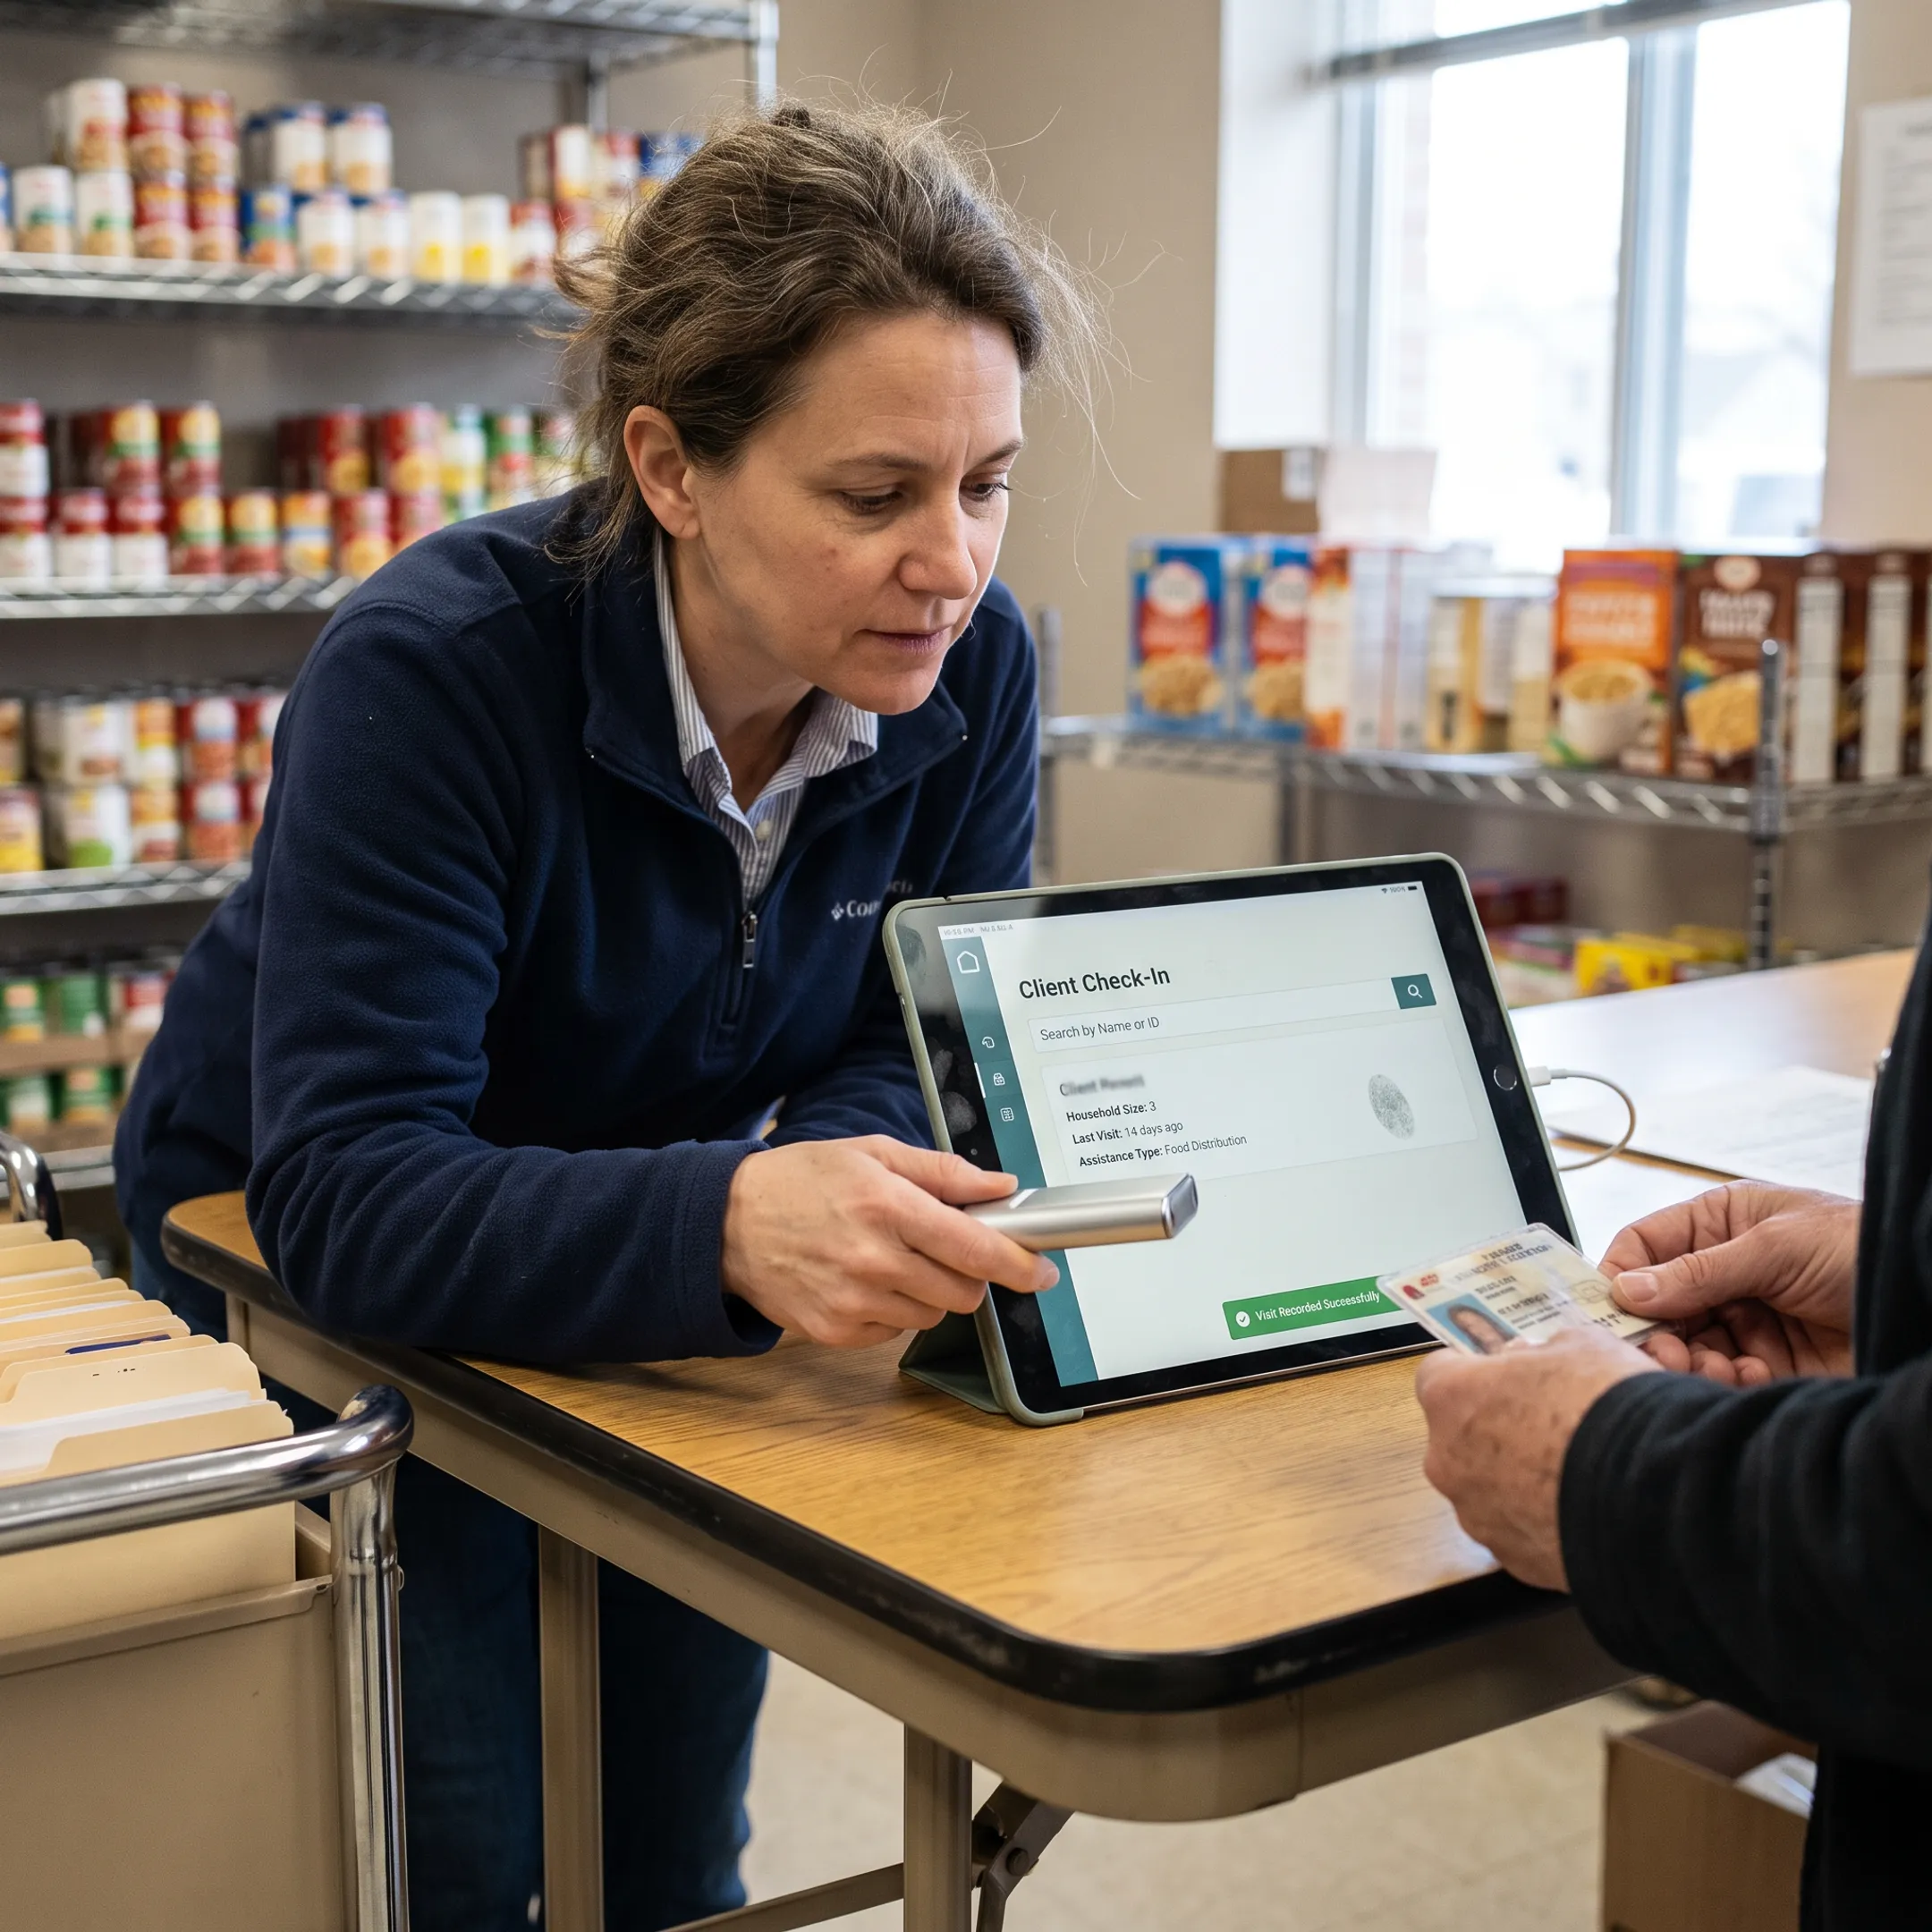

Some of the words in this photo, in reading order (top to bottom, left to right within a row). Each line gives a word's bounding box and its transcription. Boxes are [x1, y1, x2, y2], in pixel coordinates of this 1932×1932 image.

[1019, 977, 1079, 999] Client
[1081, 968, 1171, 993] Check-In
[1040, 1025, 1080, 1041] Search
[1082, 1024, 1096, 1038] by
[1098, 1021, 1131, 1034] Name
[1134, 1020, 1146, 1030] or
[1148, 1016, 1160, 1028] ID
[1066, 1105, 1121, 1122] Household
[1123, 1103, 1148, 1114] Size:
[1148, 1100, 1157, 1112] 3
[1072, 1132, 1096, 1145] Last
[1096, 1129, 1123, 1141] Visit:
[1124, 1126, 1138, 1137] 14
[1140, 1124, 1163, 1137] days
[1165, 1122, 1183, 1134] ago
[1079, 1150, 1134, 1166] Assistance
[1135, 1147, 1163, 1161] Type:
[1165, 1141, 1191, 1155] Food
[1191, 1135, 1248, 1151] Distribution
[1255, 1308, 1278, 1321] Visit
[1278, 1300, 1323, 1317] Recorded
